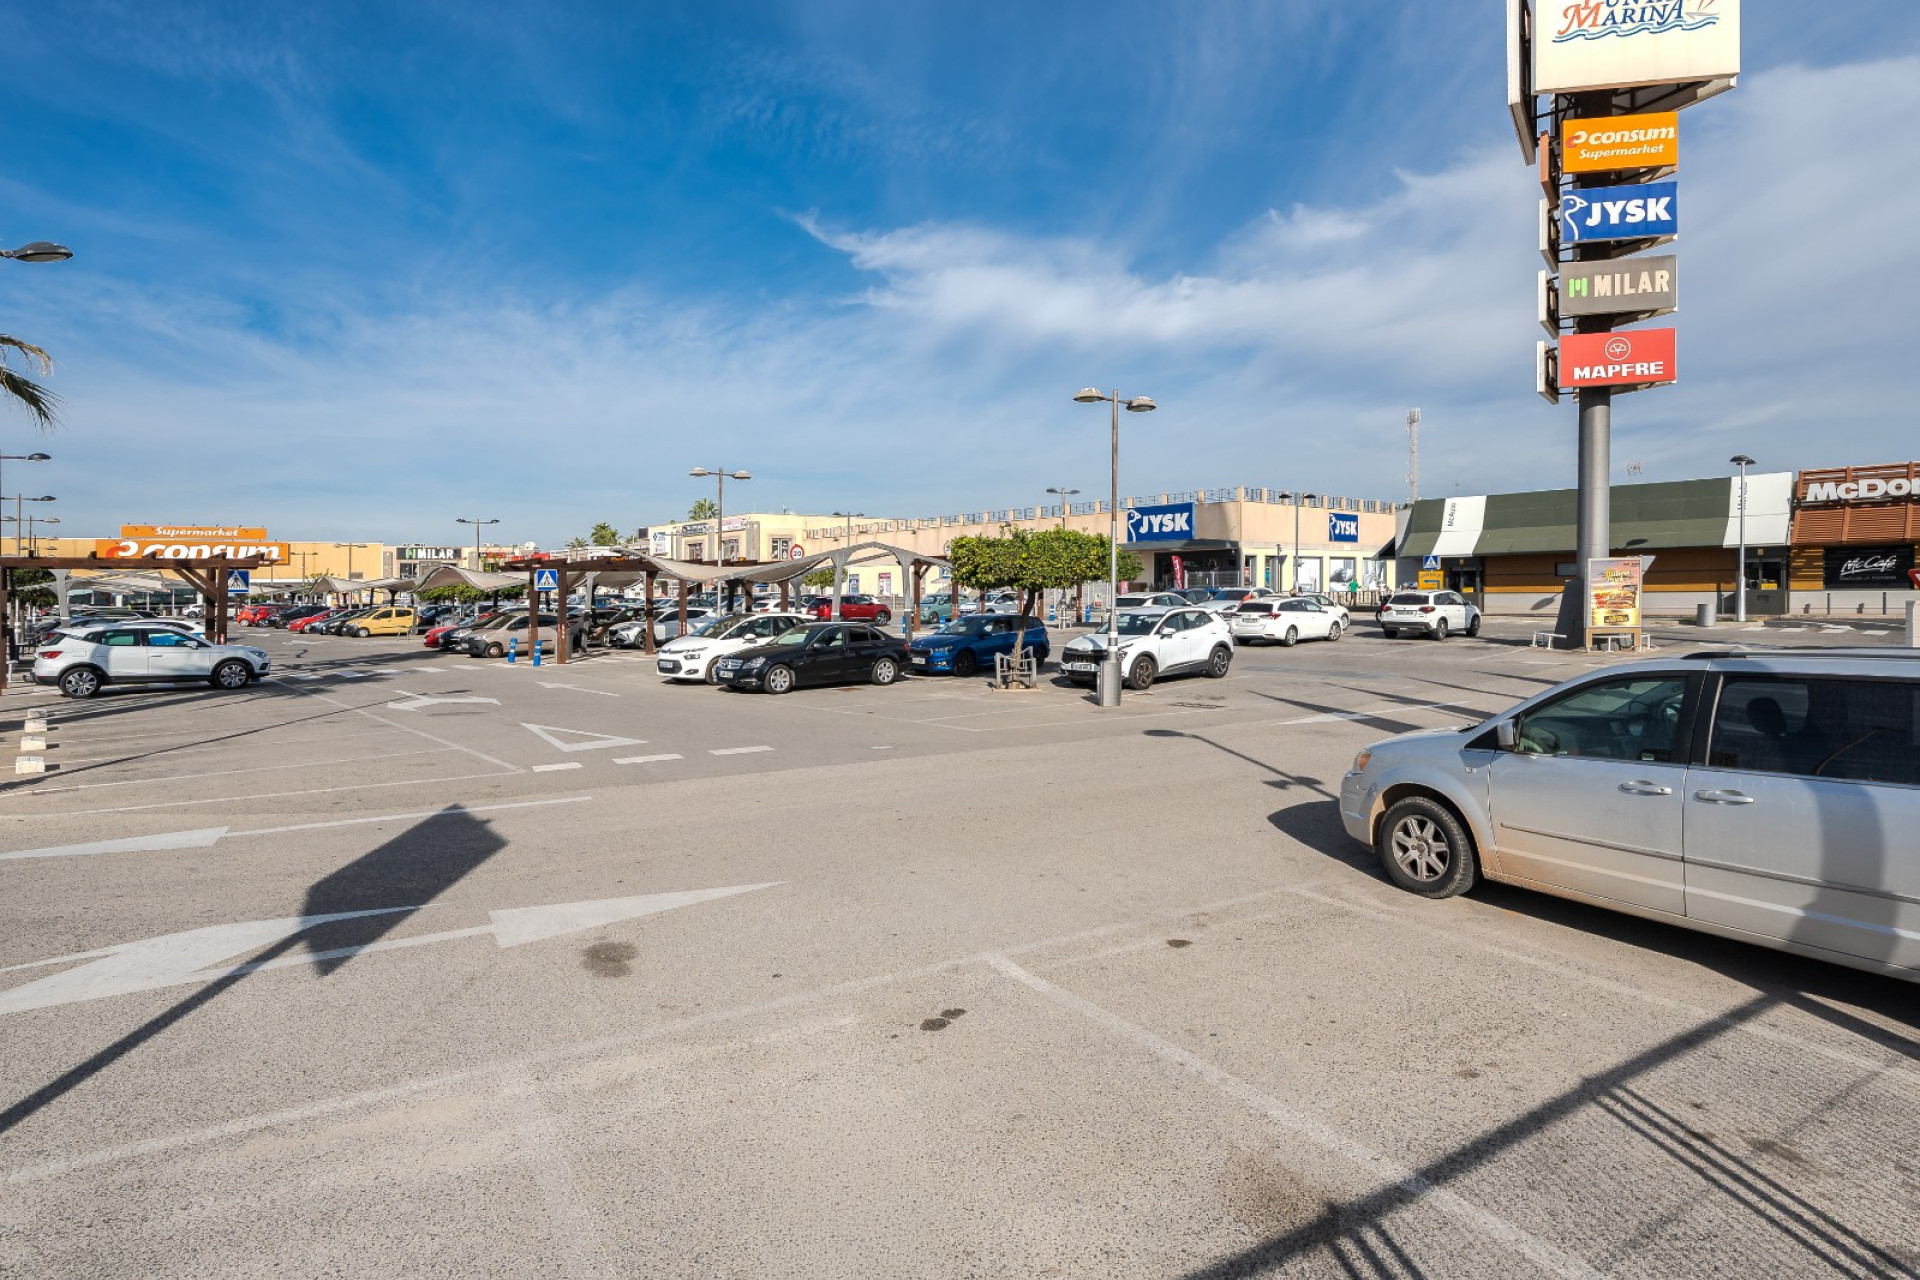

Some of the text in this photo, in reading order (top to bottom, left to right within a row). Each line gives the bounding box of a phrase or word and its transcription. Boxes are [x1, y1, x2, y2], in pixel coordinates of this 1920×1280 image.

[1589, 126, 1676, 145] consum
[1579, 144, 1664, 160] Supermarket
[1585, 196, 1672, 226] JYSK
[1594, 270, 1670, 297] MILAR
[1573, 361, 1664, 380] MAPFRE
[155, 526, 238, 537] Supermarket
[1139, 512, 1190, 534] JYSK
[1335, 520, 1357, 536] JYSK
[417, 548, 455, 560] MILAR
